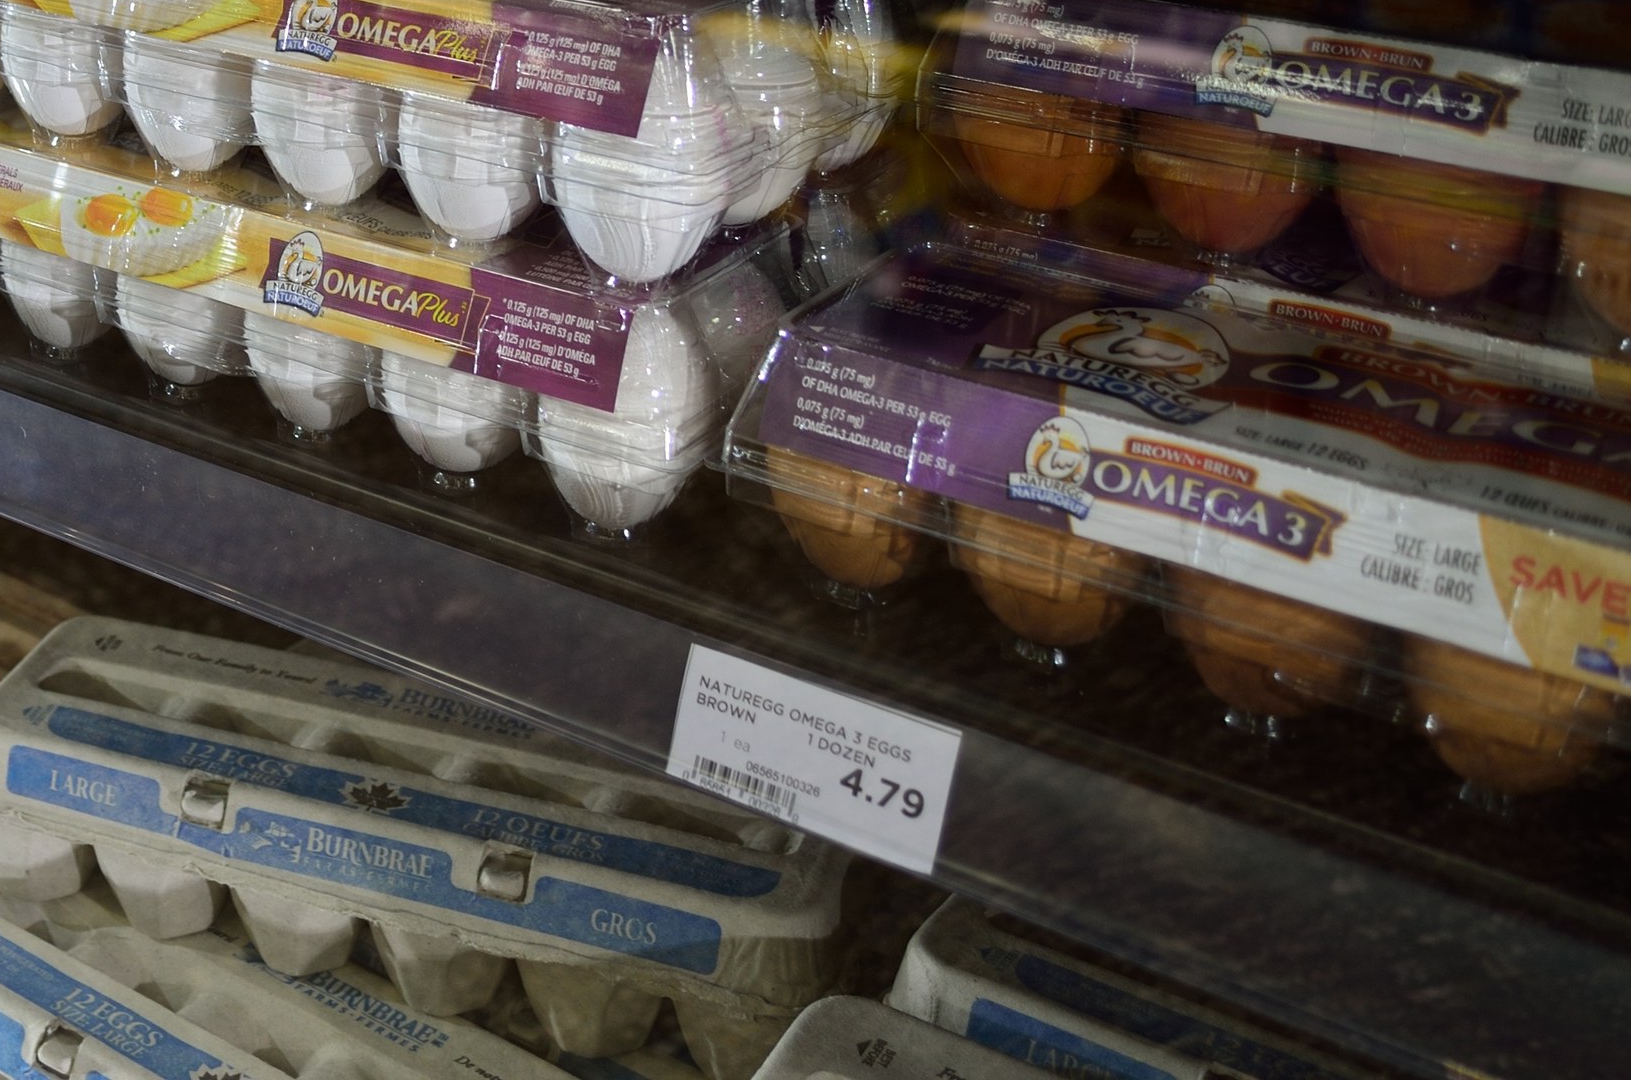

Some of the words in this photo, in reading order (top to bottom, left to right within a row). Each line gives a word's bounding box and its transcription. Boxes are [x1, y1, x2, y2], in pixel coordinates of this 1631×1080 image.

[336, 12, 436, 54] OMEGA
[435, 29, 478, 62] Plus
[1008, 14, 1030, 29] DHA
[1118, 32, 1139, 45] EGG
[525, 45, 563, 62] OMEGA-3
[563, 52, 580, 65] PER
[599, 58, 617, 71] EGG
[589, 43, 601, 53] OF
[603, 45, 621, 57] DHA
[1039, 56, 1062, 71] ADH
[1310, 40, 1370, 60] BROWN
[1378, 50, 1425, 71] BRUN
[536, 81, 552, 94] PAR
[574, 88, 585, 100] DE
[1198, 92, 1272, 115] NATUROEUF
[1274, 60, 1447, 115] OMEGA
[1533, 120, 1588, 148] CALIBRE
[1599, 129, 1631, 153] GRO
[267, 290, 318, 314] NATUROEUF
[273, 282, 318, 300] NATUREGG
[322, 268, 418, 318] OMEGA
[417, 292, 460, 327] Plus
[504, 313, 540, 332] OMEGA-3
[540, 322, 556, 336] PER
[574, 331, 591, 345] EGG
[564, 314, 575, 324] OF
[576, 317, 595, 331] DHA
[1275, 303, 1332, 326] BROWN
[1338, 315, 1384, 339] BRUN
[514, 349, 531, 364] PAR
[552, 359, 563, 372] DE
[1011, 349, 1201, 406] NATUREGG
[1340, 348, 1503, 403] BROWN
[857, 373, 875, 389] mg)
[985, 358, 1207, 421] NATUROEUF
[797, 397, 822, 414] 0,075
[847, 413, 865, 429] mg)
[802, 376, 817, 388] OF
[817, 380, 838, 397] DHA
[840, 387, 884, 409] OMEGA-3
[885, 400, 904, 415] PER
[906, 404, 918, 418] 53
[928, 411, 952, 427] EGG
[848, 432, 871, 448] ADH
[871, 438, 892, 455] PAR
[918, 452, 933, 467] DE
[934, 455, 947, 470] 53
[1129, 439, 1197, 467] BROWN
[1199, 457, 1251, 485] BRUN
[1011, 488, 1088, 514] NATUROEUF
[1020, 474, 1085, 501] NATUREGG
[1092, 459, 1272, 542] OMEGA
[1276, 512, 1308, 548] 3
[1433, 543, 1482, 575] LARGE
[1360, 552, 1420, 590] CALIBRE
[1434, 576, 1474, 605] GROS
[1509, 555, 1631, 617] SAVE
[696, 692, 757, 725] BROWN
[818, 736, 876, 769] DOZEN
[699, 674, 784, 717] NATUREGG
[789, 708, 847, 740] OMEGA
[868, 736, 912, 763] EGGS
[183, 741, 211, 760] 12
[218, 748, 300, 779] EGGS
[745, 759, 821, 799] 06565100326
[48, 768, 118, 808] LARGE
[839, 768, 925, 820] 4.79
[472, 809, 499, 826] 12
[506, 815, 606, 851] OEUFS
[306, 826, 435, 880] BURNBRAE
[590, 908, 658, 946] GROS
[64, 988, 96, 1010] 12
[94, 999, 164, 1049] EGGS
[312, 970, 436, 1045] BURNBRAE
[90, 1021, 146, 1060] LARGE
